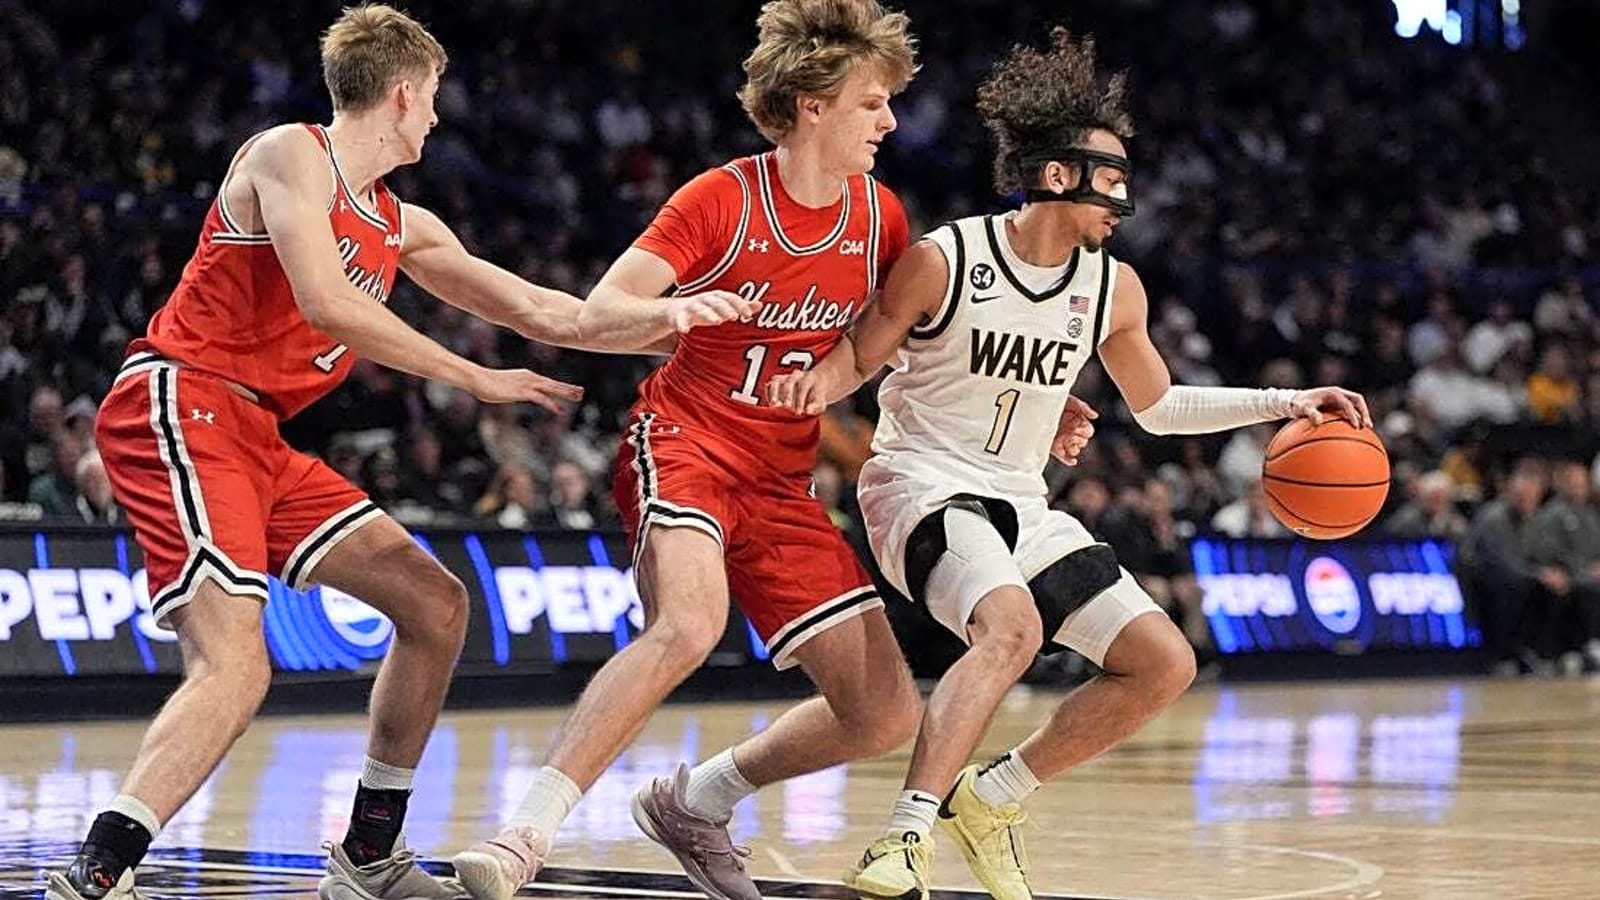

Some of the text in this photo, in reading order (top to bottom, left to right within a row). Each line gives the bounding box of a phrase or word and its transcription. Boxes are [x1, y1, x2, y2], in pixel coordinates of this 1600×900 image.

[384, 233, 401, 247] AA
[839, 240, 865, 256] CAA
[971, 264, 993, 289] 54
[737, 280, 854, 332] Huskies
[969, 328, 1079, 387] WAKE
[984, 388, 1021, 456] 1
[0, 567, 179, 642] PEP
[495, 566, 645, 634] PEP
